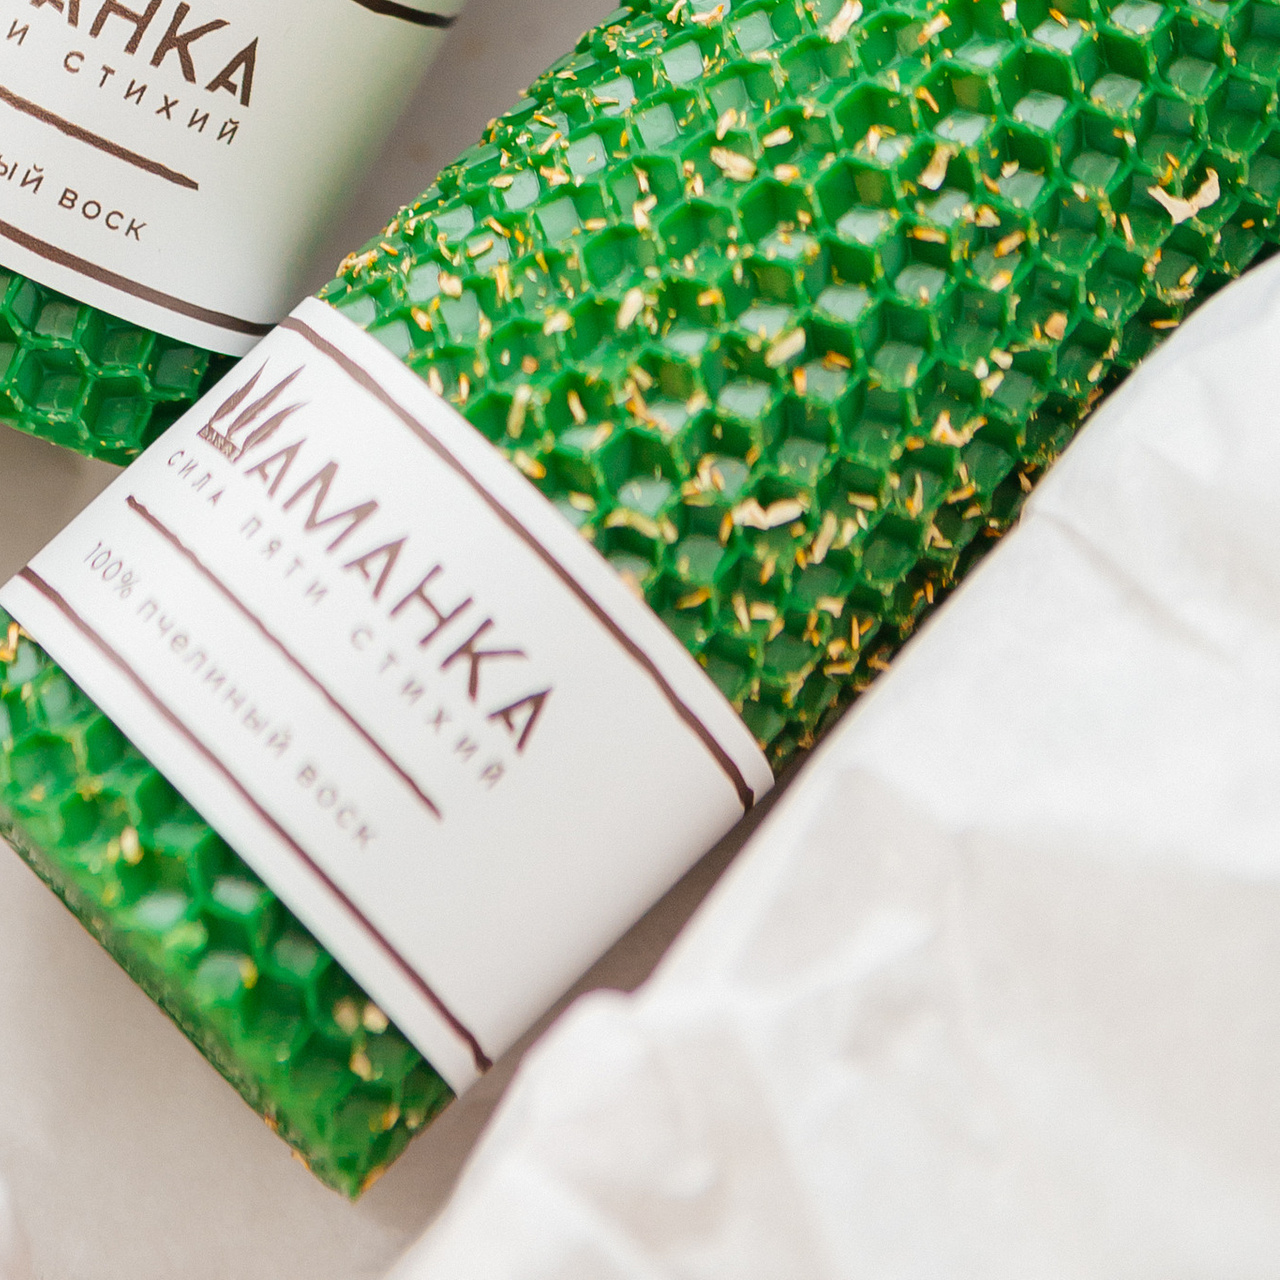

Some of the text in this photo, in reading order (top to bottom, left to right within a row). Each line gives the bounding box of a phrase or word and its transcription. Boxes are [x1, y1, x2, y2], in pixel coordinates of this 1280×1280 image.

[63, 50, 240, 146] СТИХИЙ
[57, 187, 149, 242] воск
[83, 540, 137, 600] 100%
[195, 356, 555, 758] ШАМАНКА
[165, 449, 506, 790] СИЛА ПЯТИ СТИХИЙ
